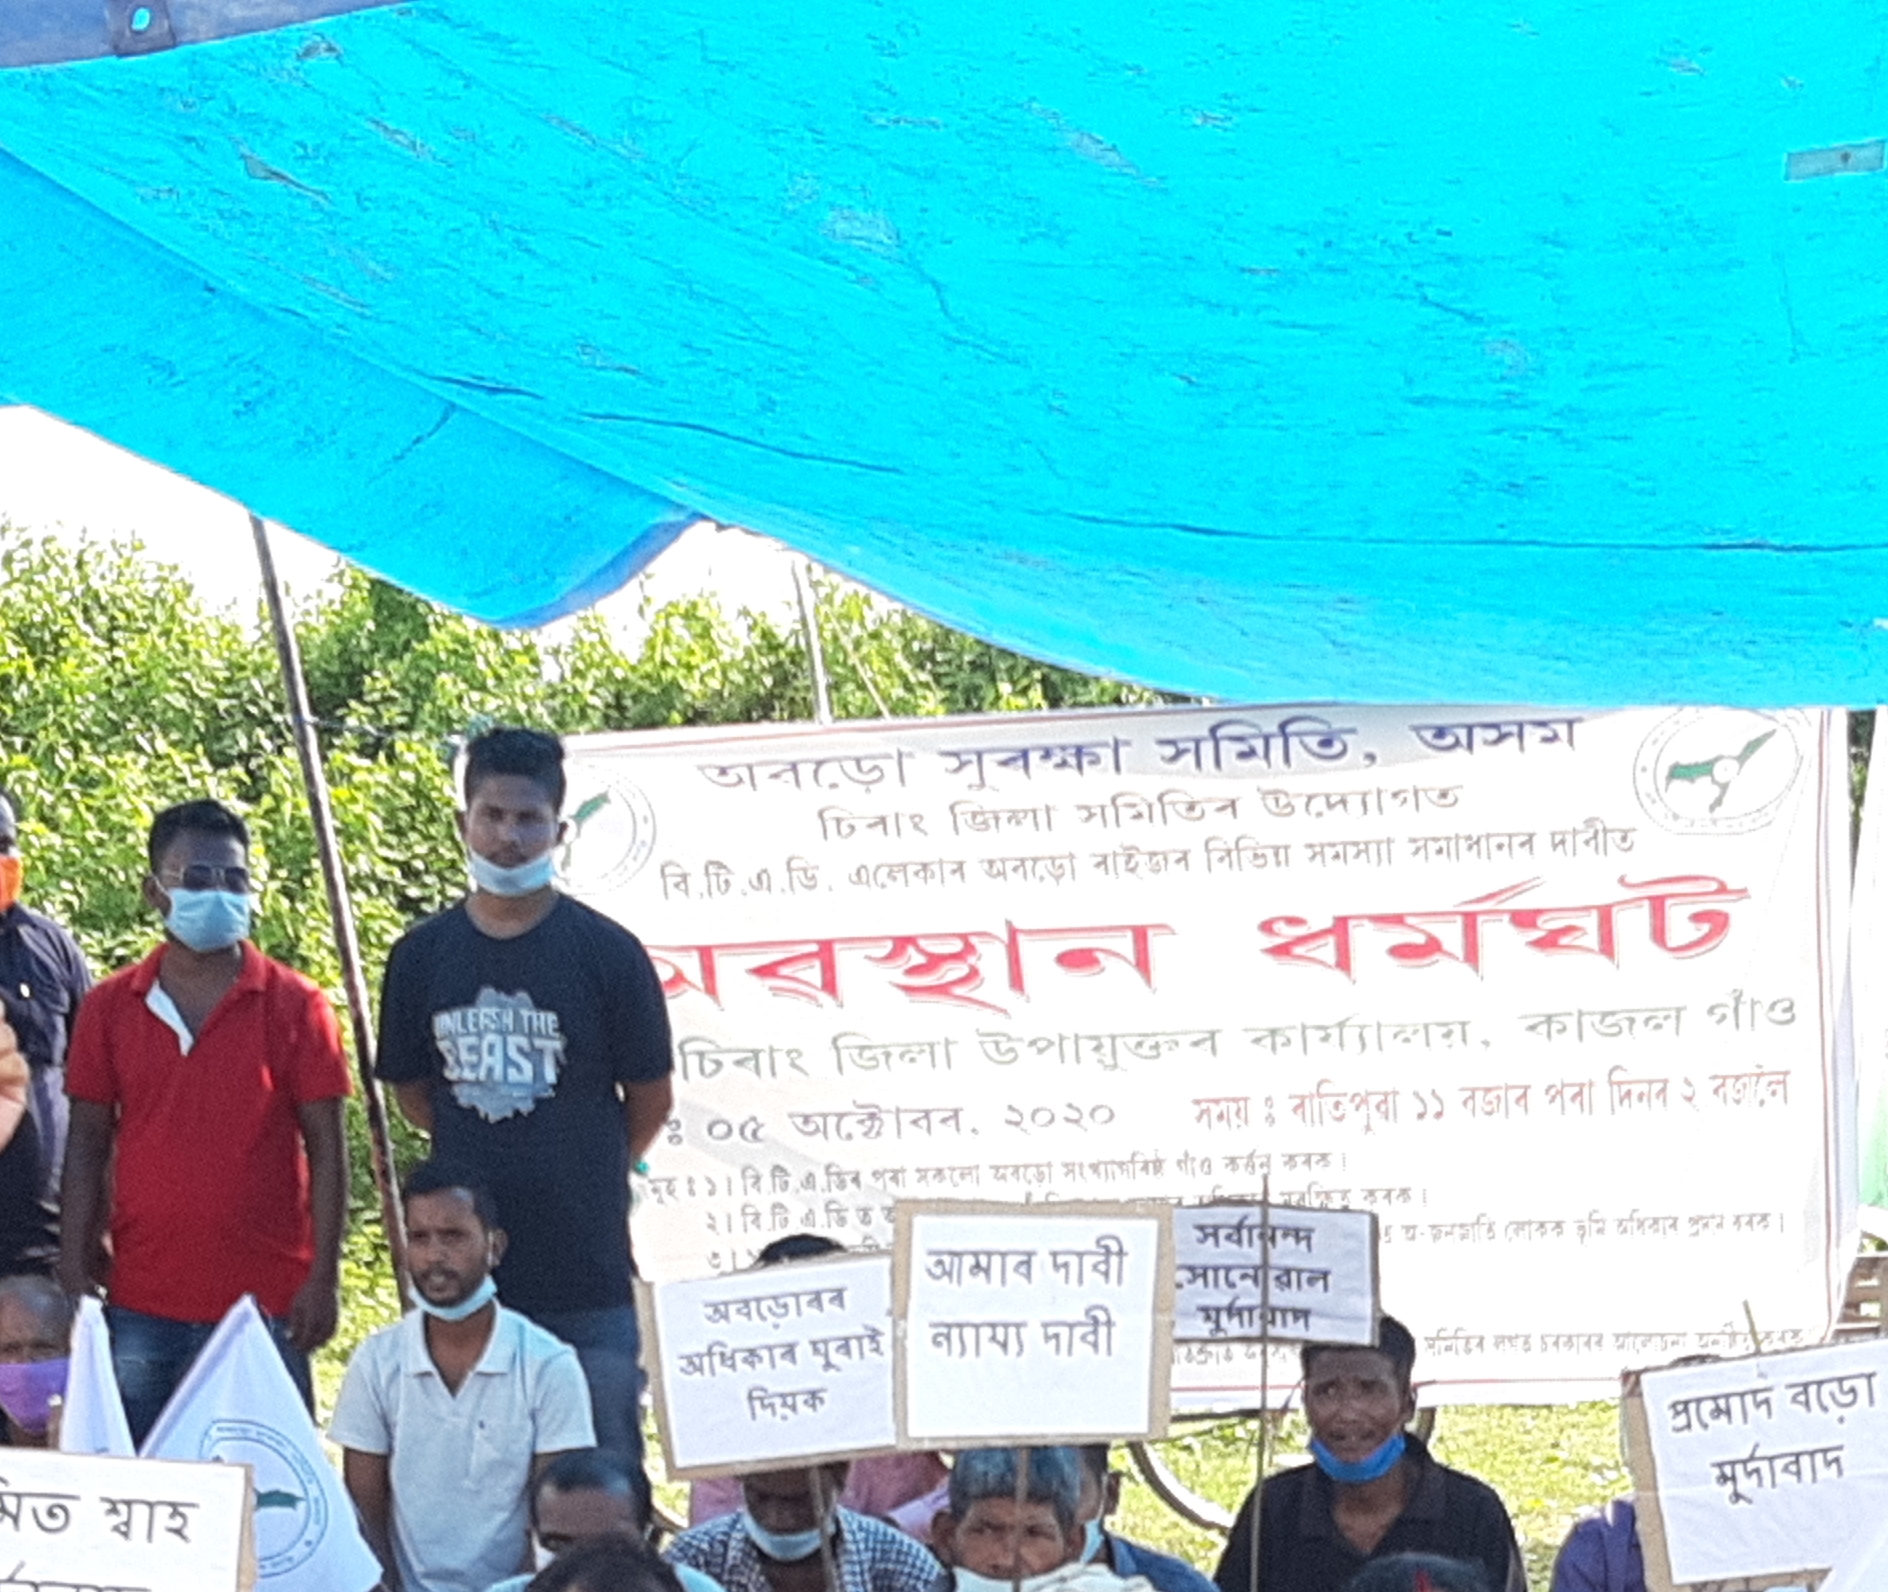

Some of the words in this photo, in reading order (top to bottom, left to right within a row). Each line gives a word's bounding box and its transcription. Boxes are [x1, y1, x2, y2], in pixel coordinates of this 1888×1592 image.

[1411, 717, 1585, 753] অসম
[950, 800, 1058, 836] জিলা
[433, 1007, 514, 1039] UNLEASH
[520, 1009, 561, 1038] THE
[832, 1031, 958, 1075] জিলা
[1519, 1004, 1687, 1044] কাজল
[435, 1033, 567, 1085] BEAST
[706, 1115, 764, 1144] ০৫
[1004, 1102, 1115, 1131] ২০২০
[1049, 1234, 1129, 1287] দাবী
[1040, 1305, 1116, 1357] দাবী
[1785, 1371, 1877, 1424] বড়ো
